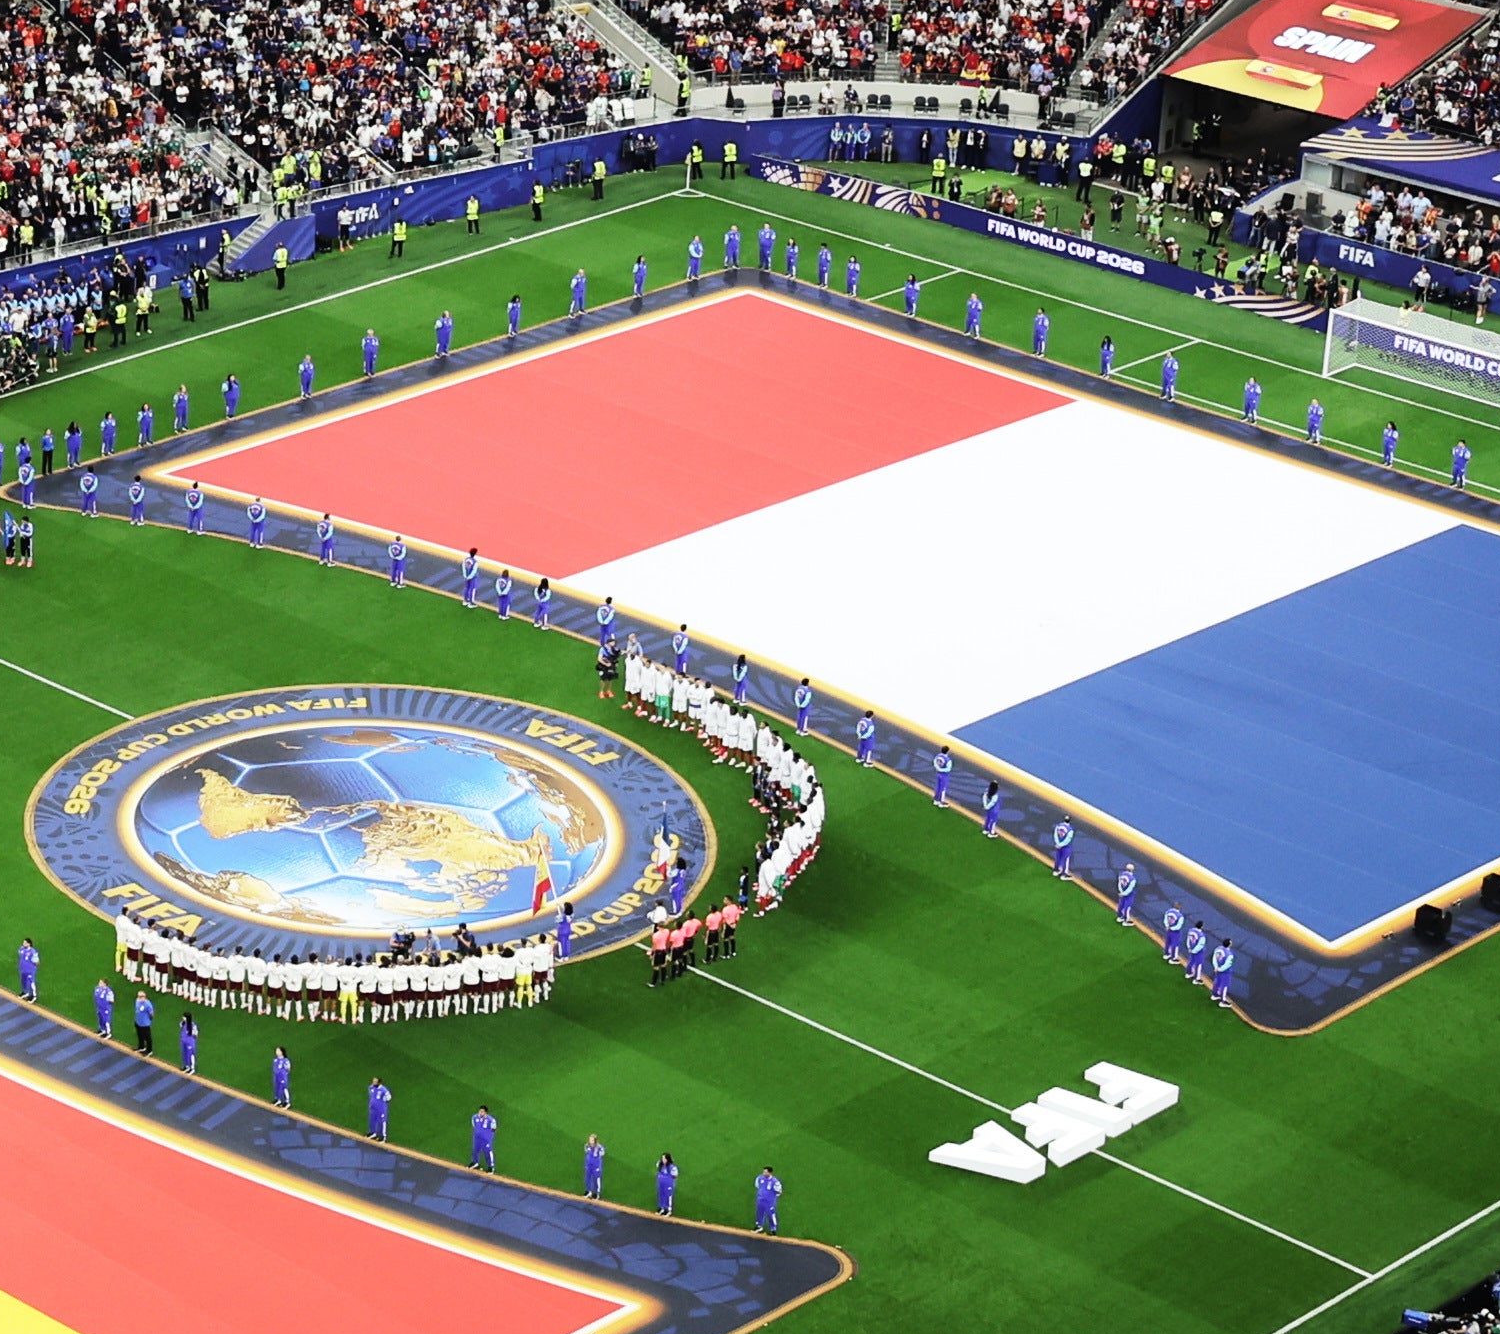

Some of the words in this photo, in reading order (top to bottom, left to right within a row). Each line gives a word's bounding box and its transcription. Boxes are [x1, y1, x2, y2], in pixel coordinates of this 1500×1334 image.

[1274, 27, 1375, 64] SPAIN
[988, 218, 1017, 242] FIFA
[1017, 224, 1066, 253] WORLD
[1067, 236, 1096, 260] CUP
[1096, 249, 1146, 275] 2026
[1339, 244, 1375, 268] FIFA
[1393, 334, 1427, 358] FIFA
[1426, 341, 1485, 373] WORLD
[166, 702, 286, 737] WORLD
[284, 697, 368, 713] FIFA
[117, 733, 169, 762] CUP
[524, 718, 620, 766] FIFA
[64, 758, 123, 815] 2026
[101, 883, 203, 938] FIFA
[592, 893, 641, 926] CUP
[928, 1061, 1180, 1185] FIFA
